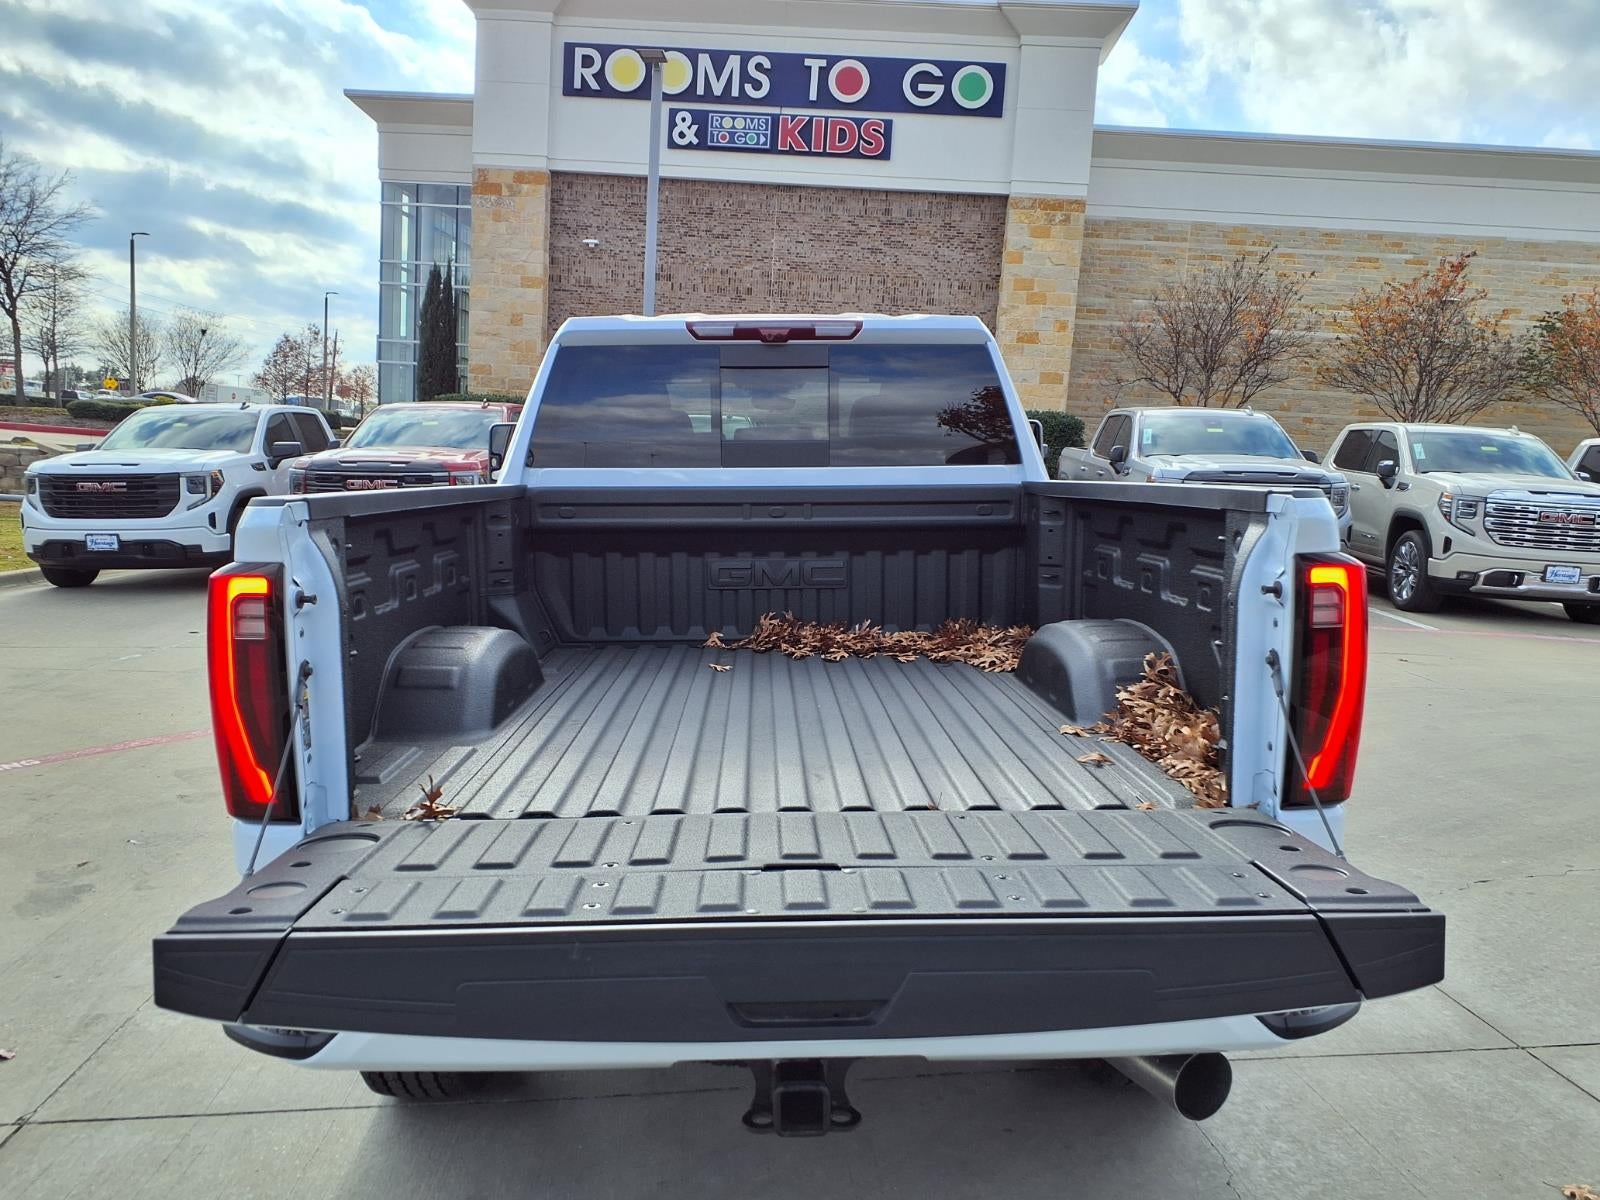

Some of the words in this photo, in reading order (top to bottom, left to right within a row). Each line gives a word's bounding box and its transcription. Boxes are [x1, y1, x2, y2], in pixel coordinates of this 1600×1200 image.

[573, 47, 772, 99] ROOMS
[804, 58, 870, 103] TO
[902, 63, 994, 109] GO
[672, 110, 699, 145] &
[712, 116, 766, 130] ROOMS
[712, 131, 730, 143] TO
[734, 132, 757, 145] GO
[778, 115, 885, 156] KIDS
[76, 482, 127, 492] GMC
[347, 480, 398, 489] GMC
[1540, 511, 1595, 525] GMC
[710, 559, 845, 587] GMC
